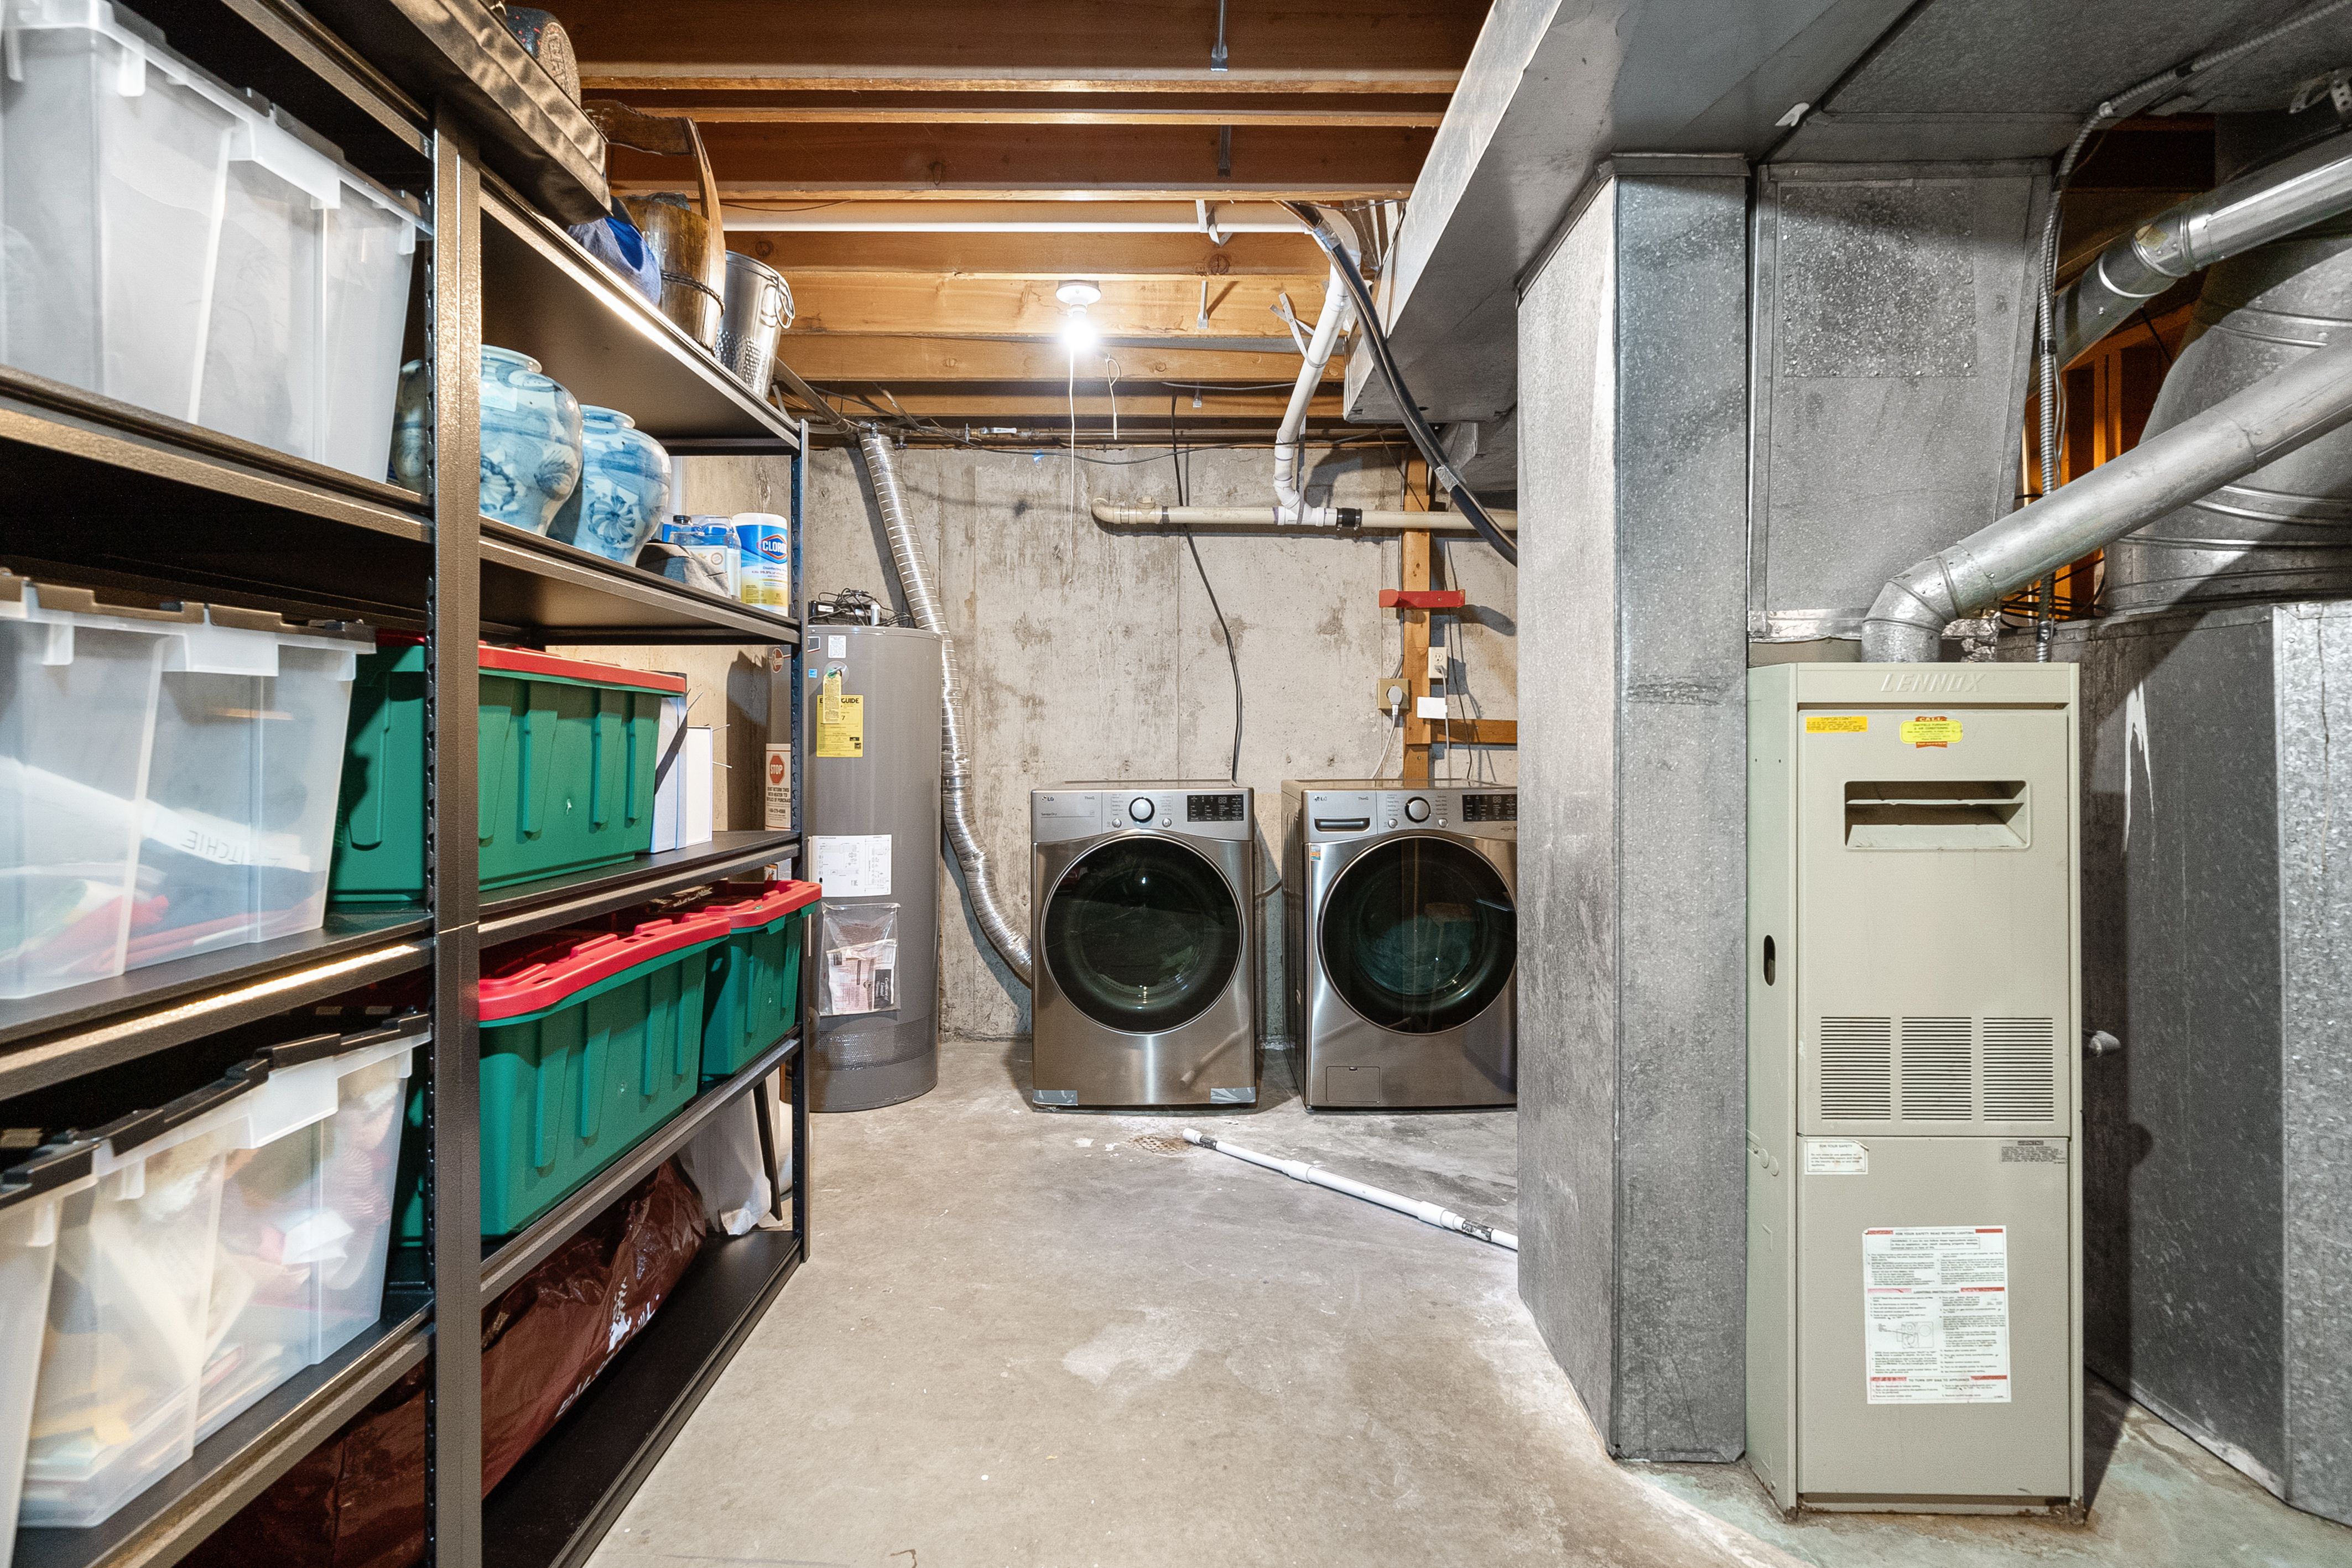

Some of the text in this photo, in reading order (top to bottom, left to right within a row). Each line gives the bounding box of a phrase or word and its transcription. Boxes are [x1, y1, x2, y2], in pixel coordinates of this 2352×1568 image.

[1881, 674, 1986, 692] LENNOX
[771, 764, 783, 774] STOP
[181, 830, 256, 865] ITCHIE
